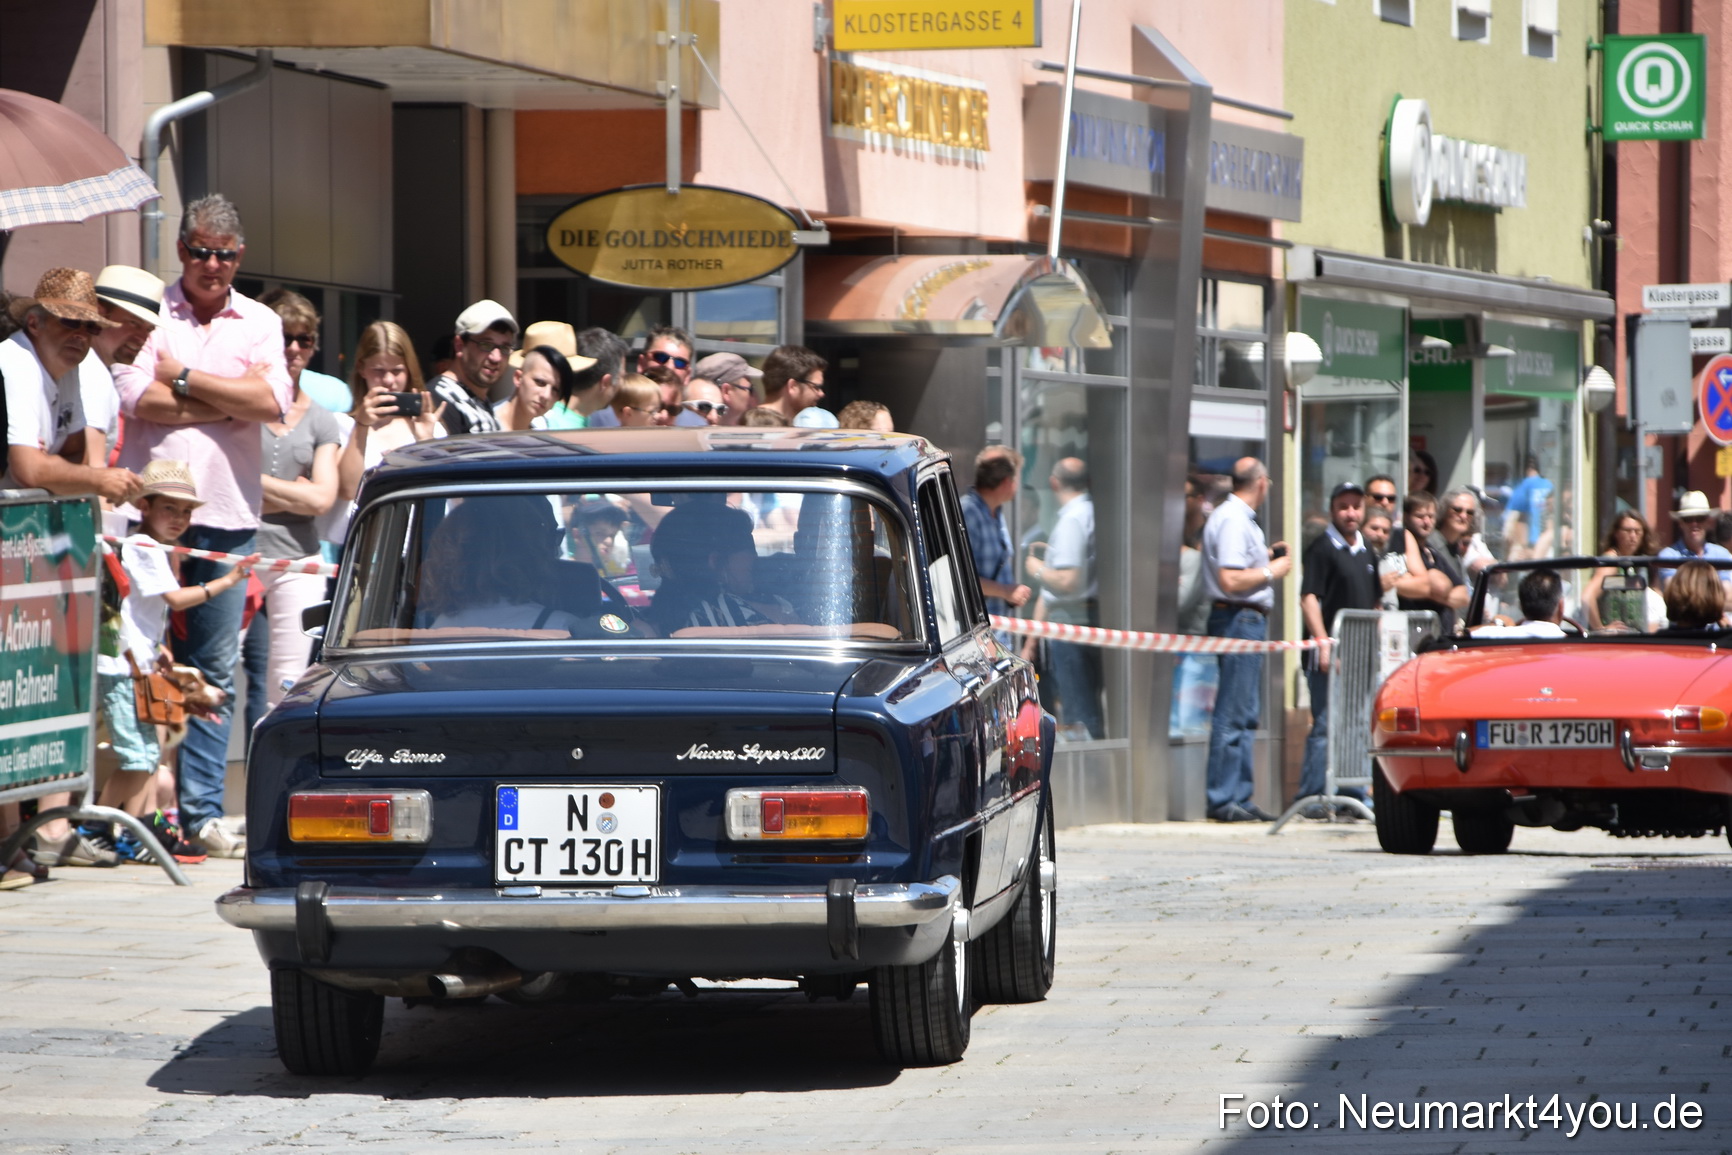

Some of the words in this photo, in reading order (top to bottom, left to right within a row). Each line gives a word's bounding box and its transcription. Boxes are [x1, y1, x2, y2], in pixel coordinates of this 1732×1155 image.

[844, 10, 1002, 34] KLOSTERGASSE
[1011, 10, 1023, 30] 4
[1614, 121, 1651, 133] QUICK
[1653, 120, 1694, 132] SCHUH
[559, 229, 599, 248] DIE
[605, 229, 792, 249] GOLDSCHMIEDE
[621, 259, 663, 271] JUTTA
[667, 258, 723, 271] ROTHER
[1647, 288, 1720, 304] Klostergasse
[1692, 335, 1725, 350] gasse
[4, 609, 39, 652] Action
[41, 608, 52, 647] in
[15, 664, 59, 707] Bahnen!
[1489, 722, 1516, 745] FÜ
[1531, 722, 1543, 744] R
[1549, 722, 1613, 744] 1750H
[345, 748, 384, 770] Alfa
[389, 748, 447, 764] Romeo
[676, 743, 736, 761] Nuova
[737, 743, 790, 765] Super
[504, 814, 514, 826] D
[567, 794, 589, 832] N
[504, 838, 549, 876] CT
